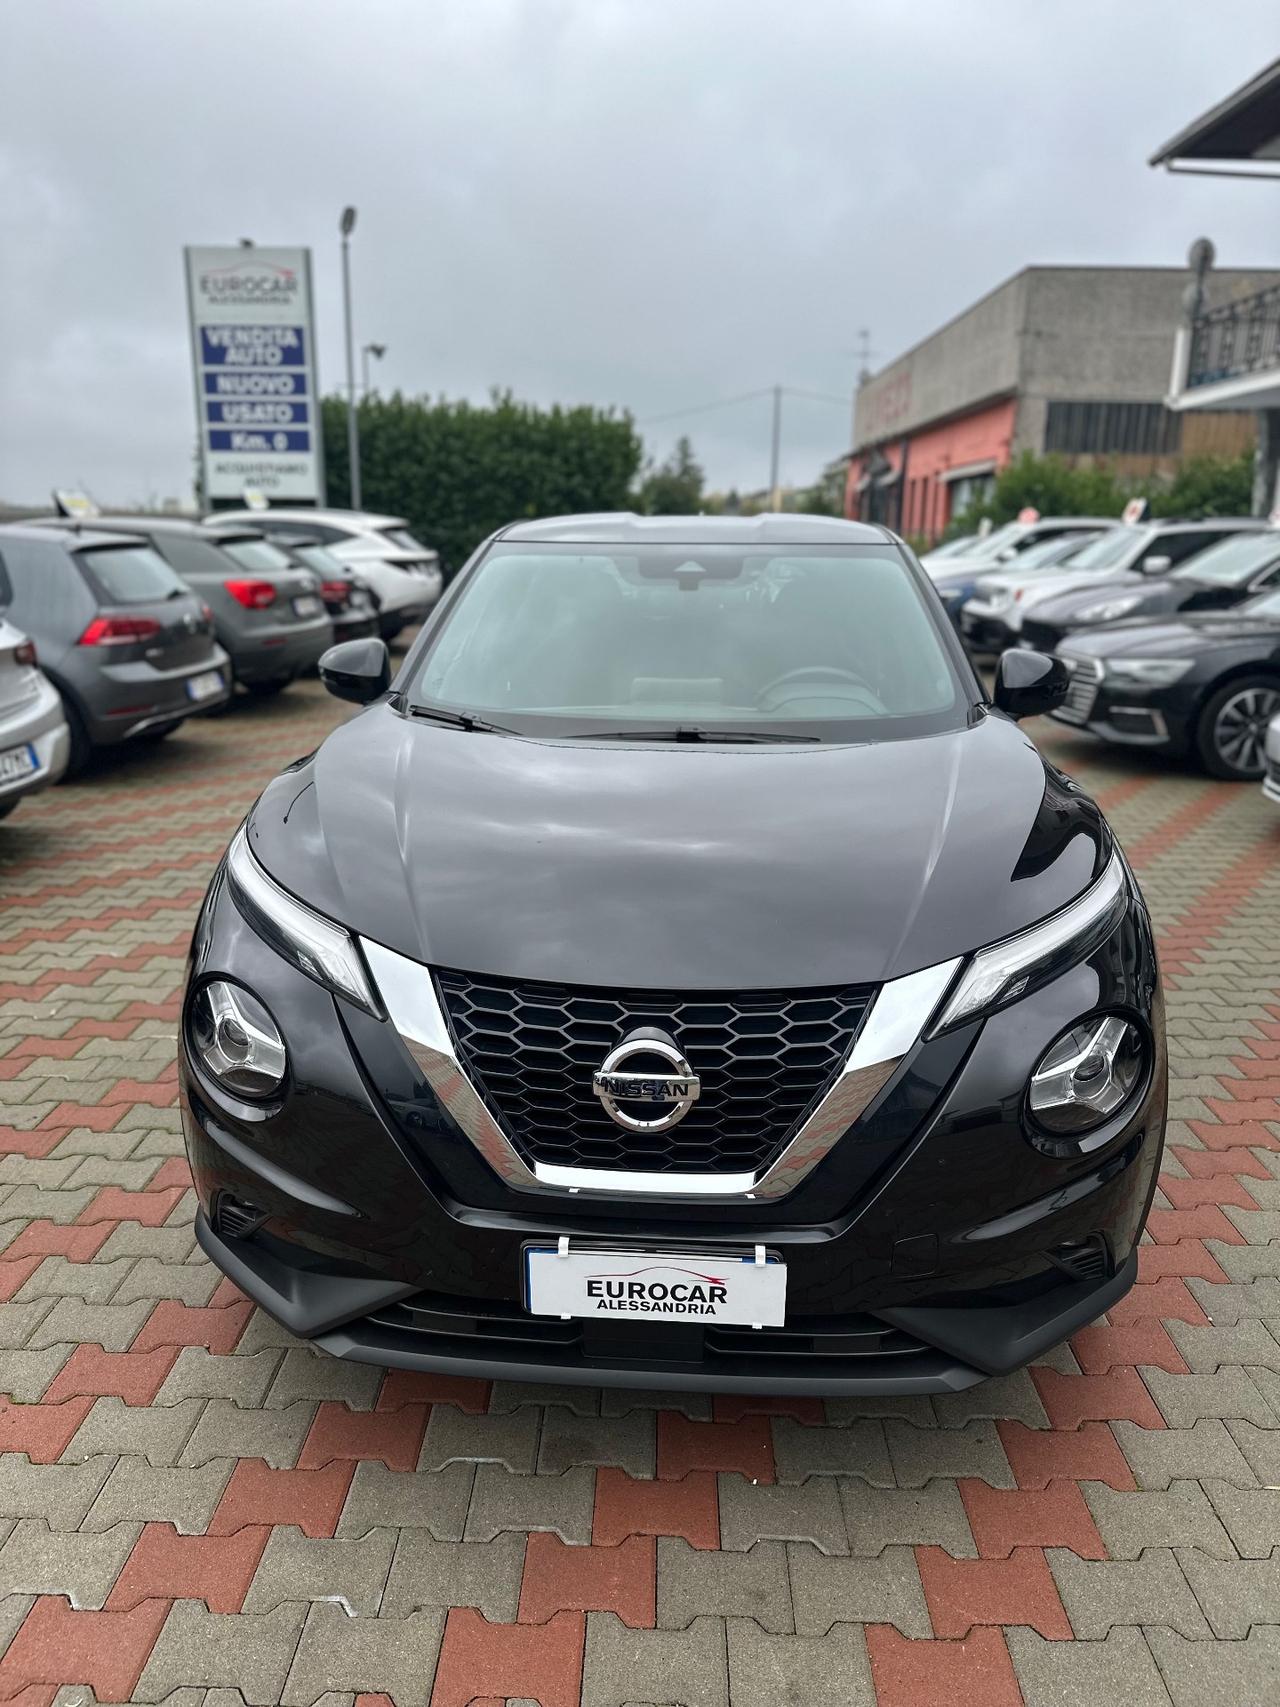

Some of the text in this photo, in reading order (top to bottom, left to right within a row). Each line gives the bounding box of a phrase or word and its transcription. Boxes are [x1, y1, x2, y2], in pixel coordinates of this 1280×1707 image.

[200, 275, 298, 294] EUROCAR
[204, 327, 300, 348] VENDITA
[224, 346, 283, 365] AUTO
[216, 375, 295, 394] NUOVO
[221, 404, 293, 422] USATO
[603, 1077, 689, 1097] NISSAN
[587, 1280, 727, 1303] EUROCAR
[597, 1299, 716, 1315] ALESSANDRIA
